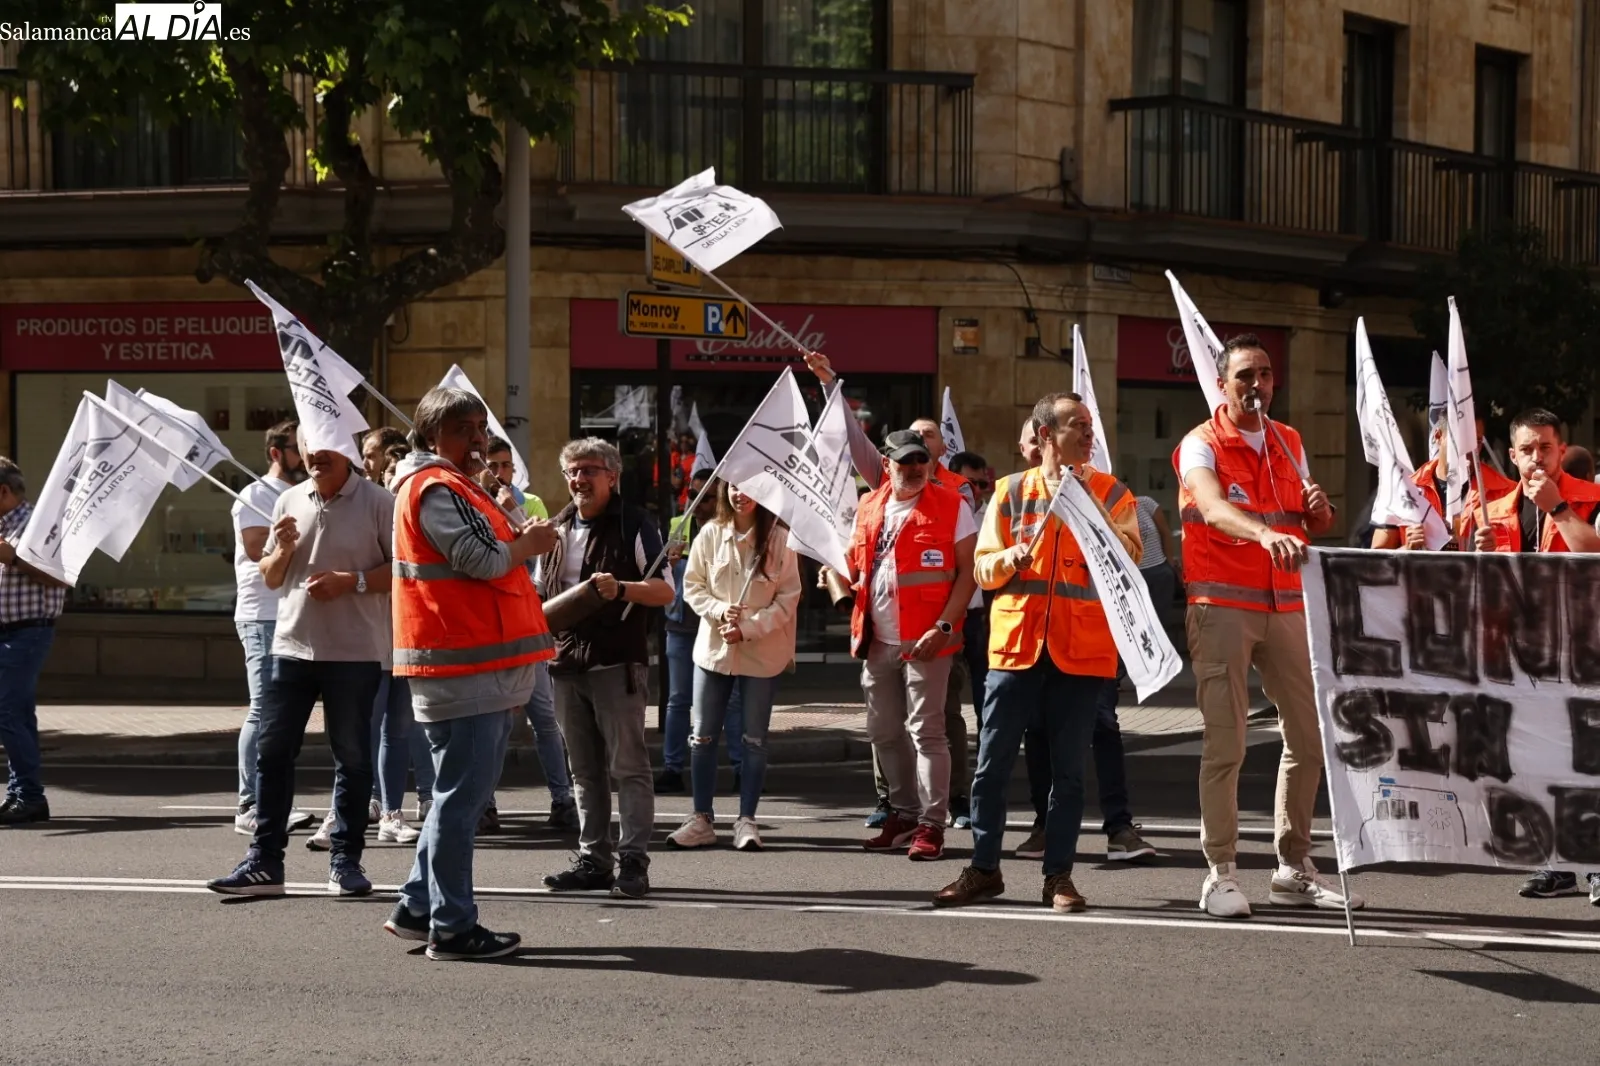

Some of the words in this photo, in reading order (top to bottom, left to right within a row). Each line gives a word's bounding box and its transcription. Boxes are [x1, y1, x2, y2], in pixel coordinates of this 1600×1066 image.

[692, 212, 731, 236] SP-TES
[701, 230, 729, 249] CASTILLA
[630, 299, 681, 322] Monroy
[16, 318, 137, 336] PRODUCTOS
[142, 317, 169, 335] DE
[101, 343, 114, 360] Y
[119, 338, 215, 360] ESTÉTICA
[307, 397, 341, 418] LEÓN
[763, 465, 807, 502] CASTILLA
[809, 499, 817, 507] Y
[784, 453, 833, 507] SP-TE
[1331, 689, 1513, 782] SIN
